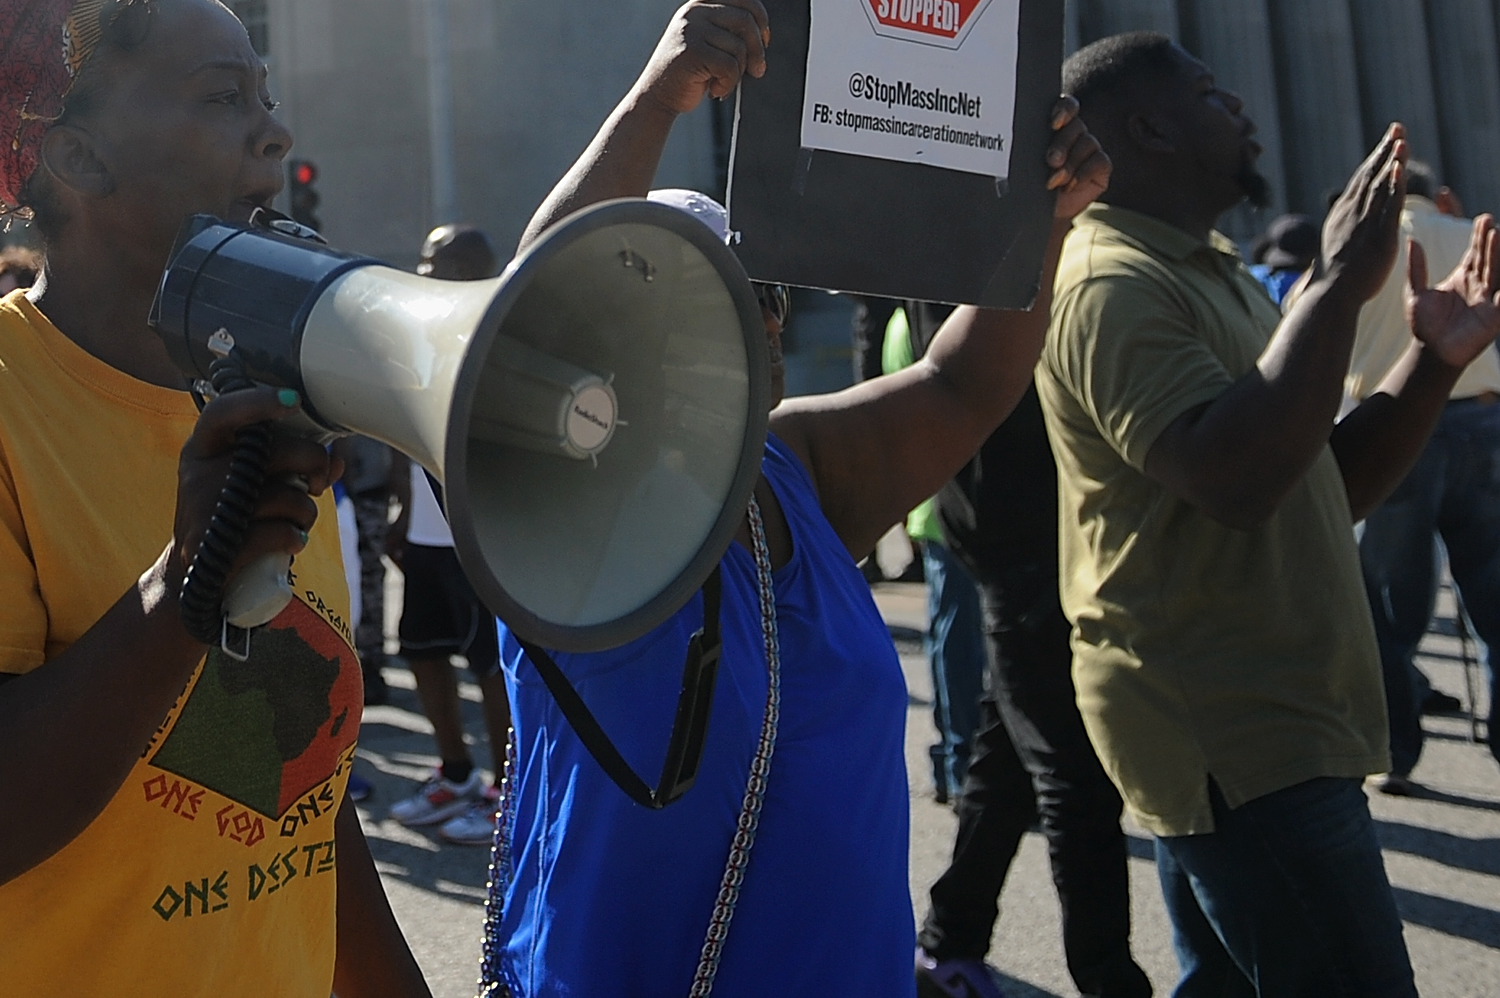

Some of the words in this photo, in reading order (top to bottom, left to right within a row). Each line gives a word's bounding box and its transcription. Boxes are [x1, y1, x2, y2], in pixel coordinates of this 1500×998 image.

[849, 72, 981, 118] @StopMassIncNet
[813, 103, 833, 125] FB:
[835, 110, 1004, 151] stopmassincarcerationnetwork
[143, 774, 206, 821] ONE
[215, 803, 265, 848] GOD
[280, 782, 335, 837] ONE
[152, 870, 228, 922] ONE
